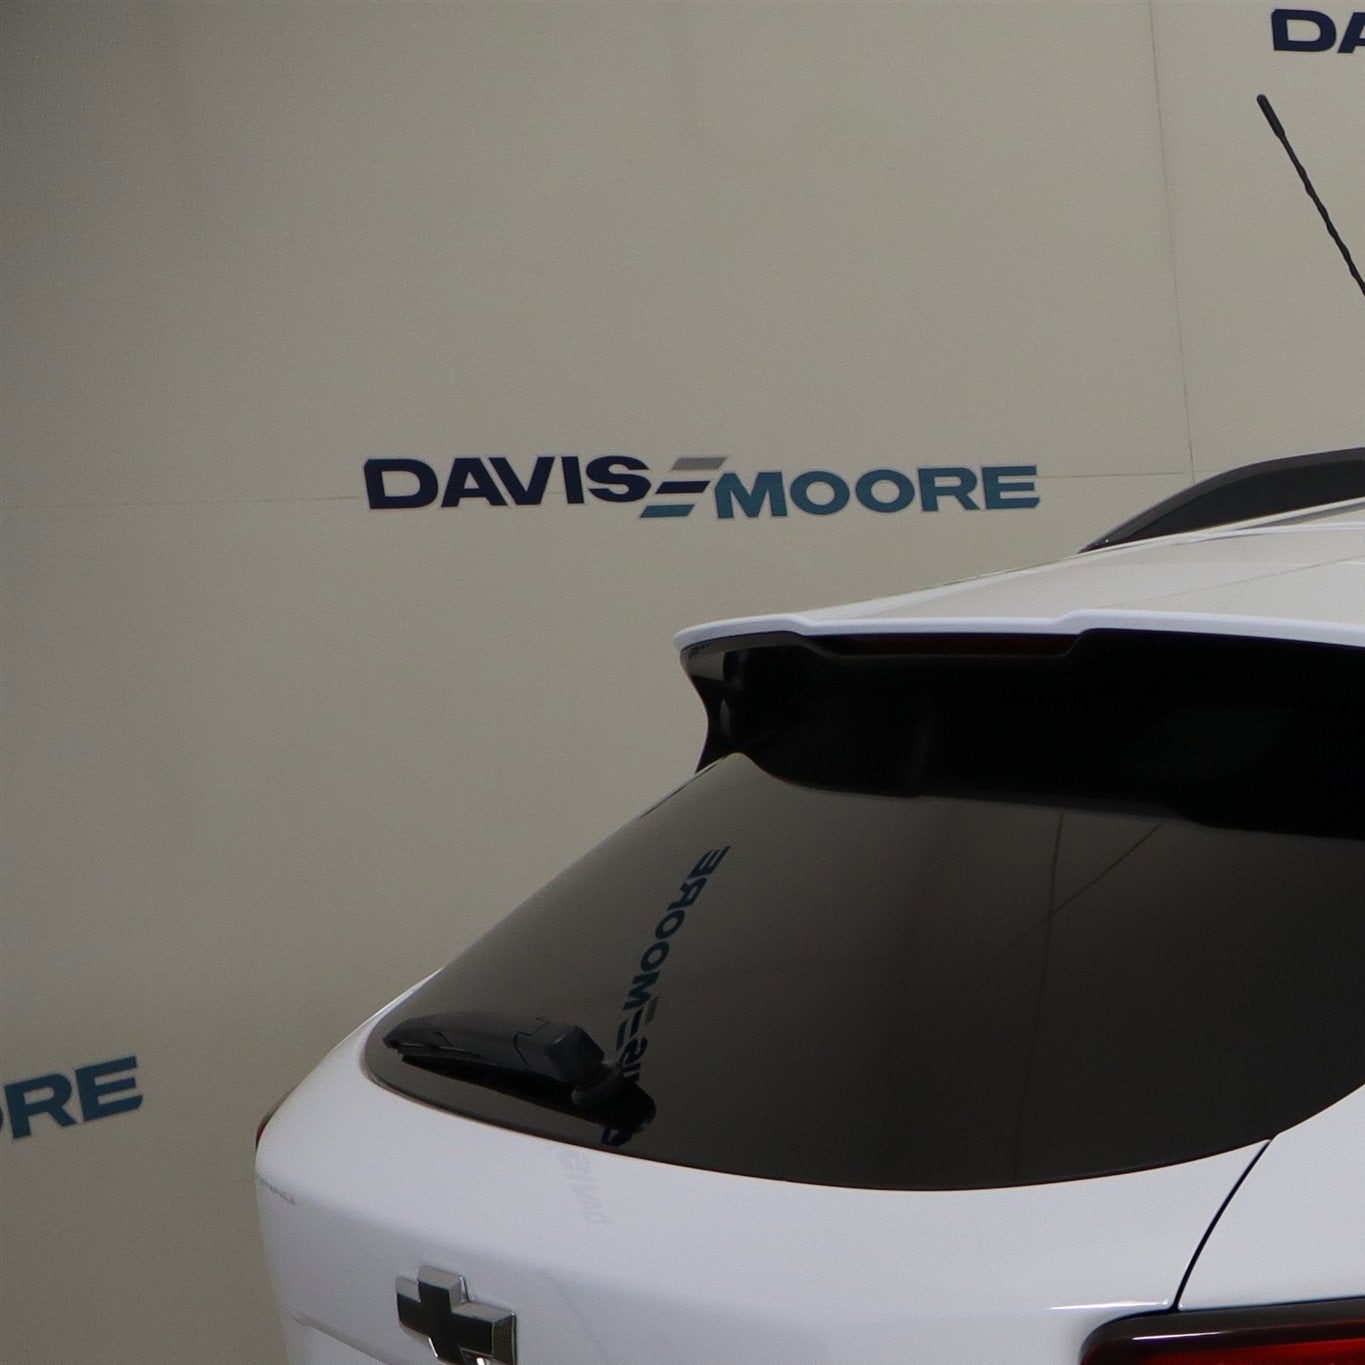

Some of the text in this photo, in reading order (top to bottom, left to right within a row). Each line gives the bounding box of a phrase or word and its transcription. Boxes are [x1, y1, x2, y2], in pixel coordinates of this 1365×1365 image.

[363, 455, 1041, 519] DAVIS MOORE
[0, 1055, 143, 1139] RE
